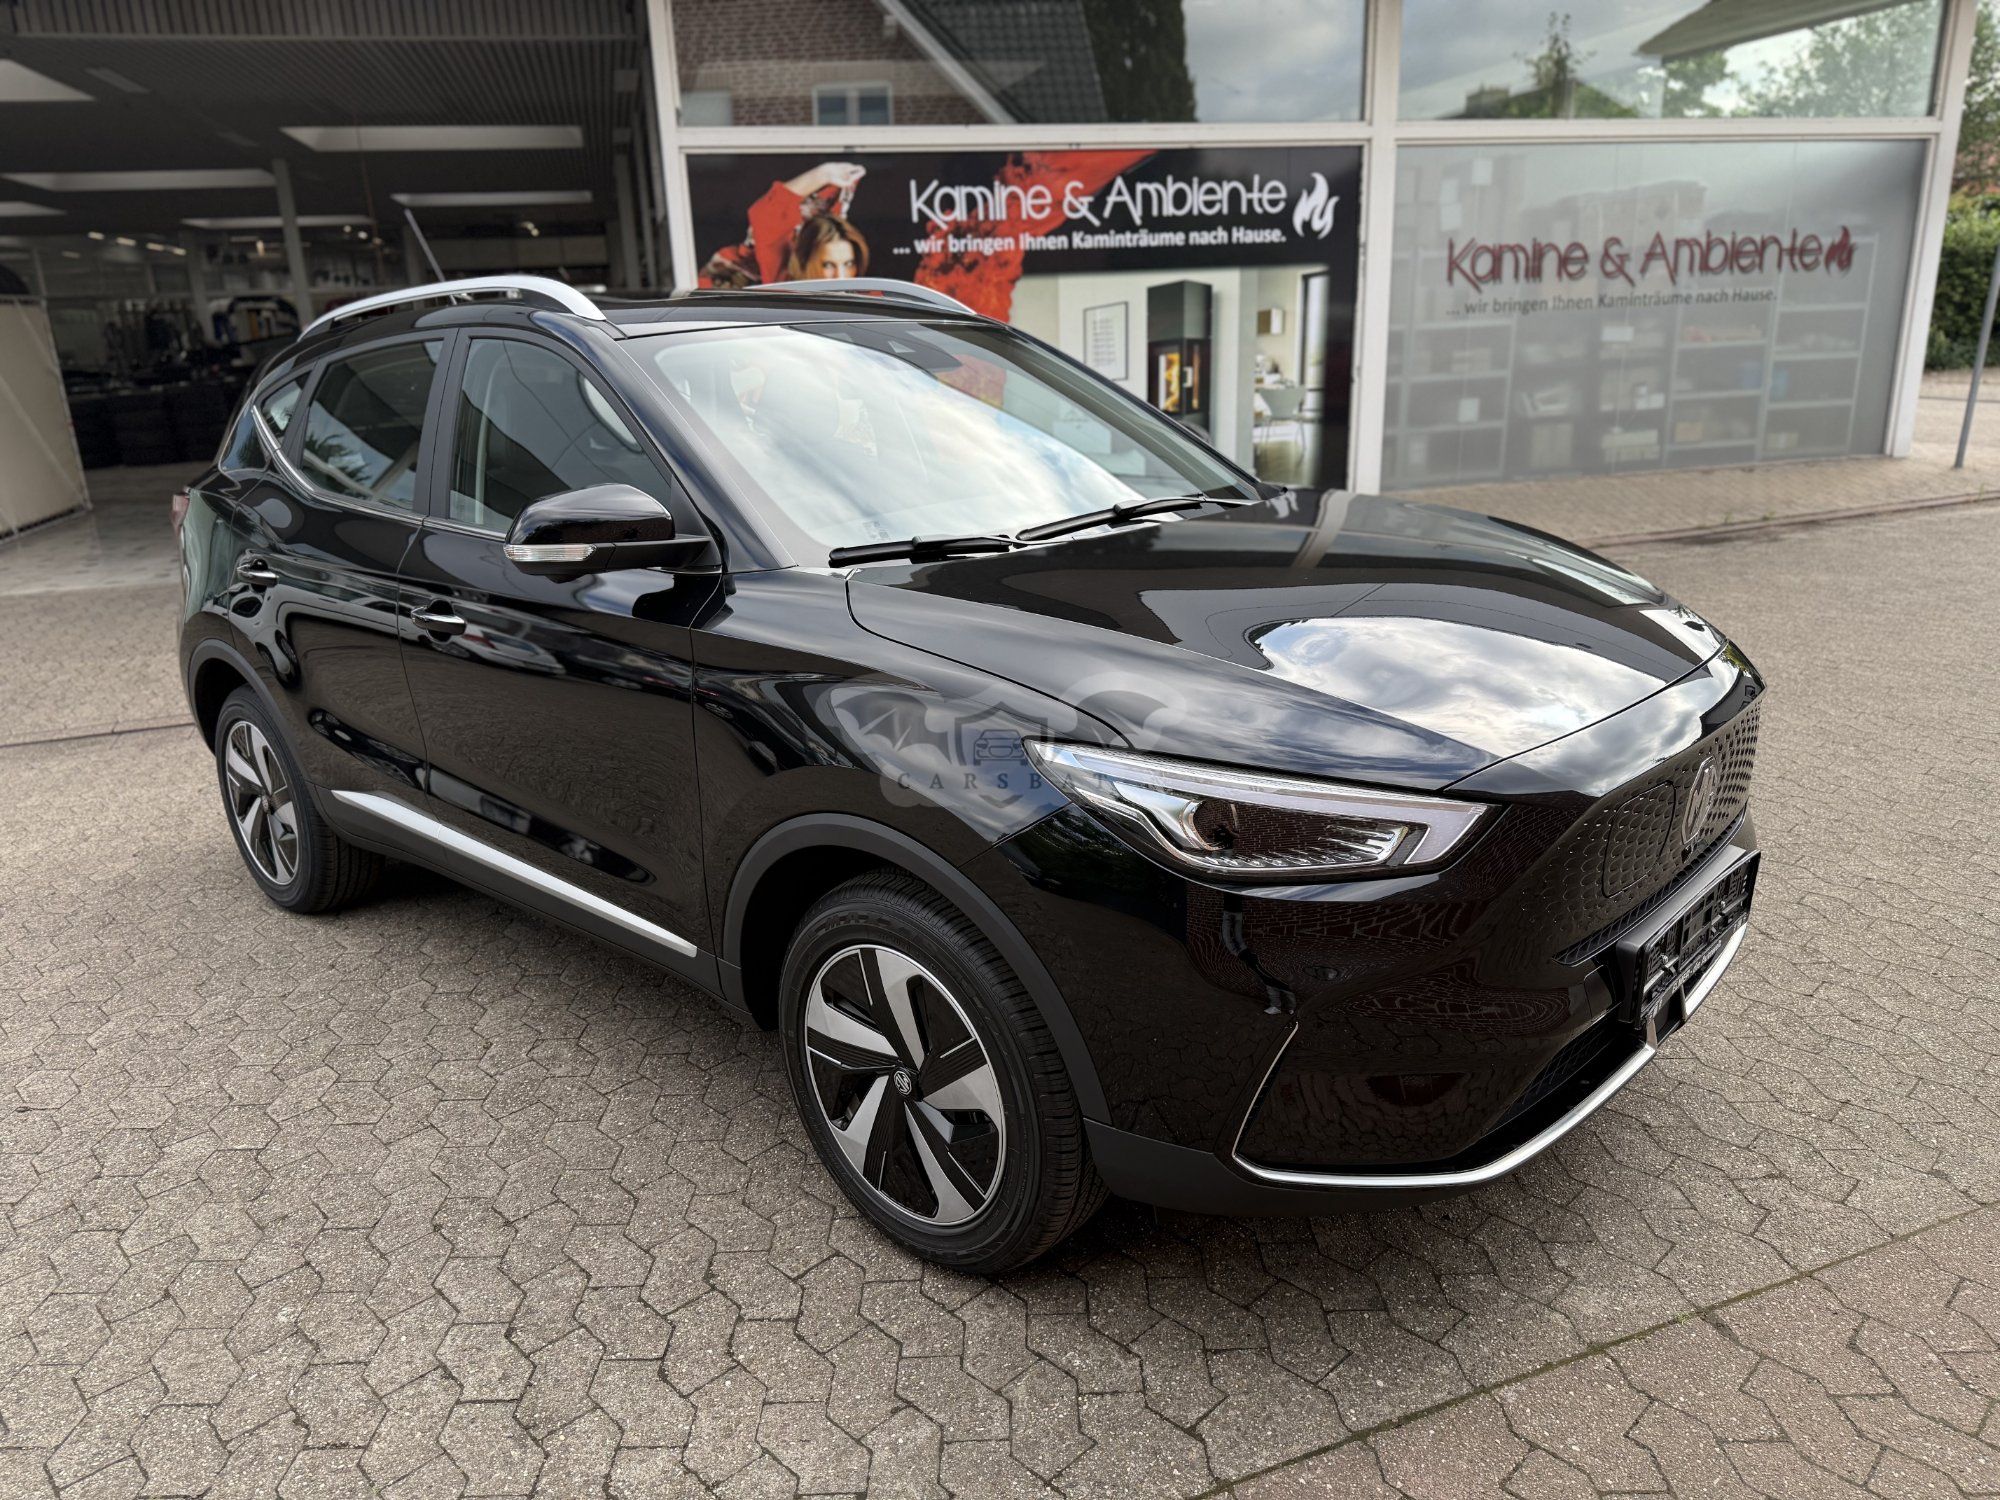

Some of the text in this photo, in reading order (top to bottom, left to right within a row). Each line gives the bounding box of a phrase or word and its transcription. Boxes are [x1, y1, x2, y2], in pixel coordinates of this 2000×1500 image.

[909, 173, 1288, 230] Kamine & Ambiente
[914, 234, 946, 254] wir
[948, 232, 1015, 257] bringen
[1019, 233, 1069, 251] Ihnen
[1071, 228, 1186, 250] Kaminträume
[1188, 227, 1229, 246] nach
[1231, 225, 1287, 244] Hause.
[1446, 228, 1824, 294] Kamine & Ambiente
[1464, 299, 1490, 316] wir
[1492, 296, 1549, 317] bringen
[1551, 294, 1594, 312] Ihnen
[1597, 287, 1693, 308] Kaminträume
[1695, 287, 1730, 305] nach
[1732, 285, 1777, 303] Hause.
